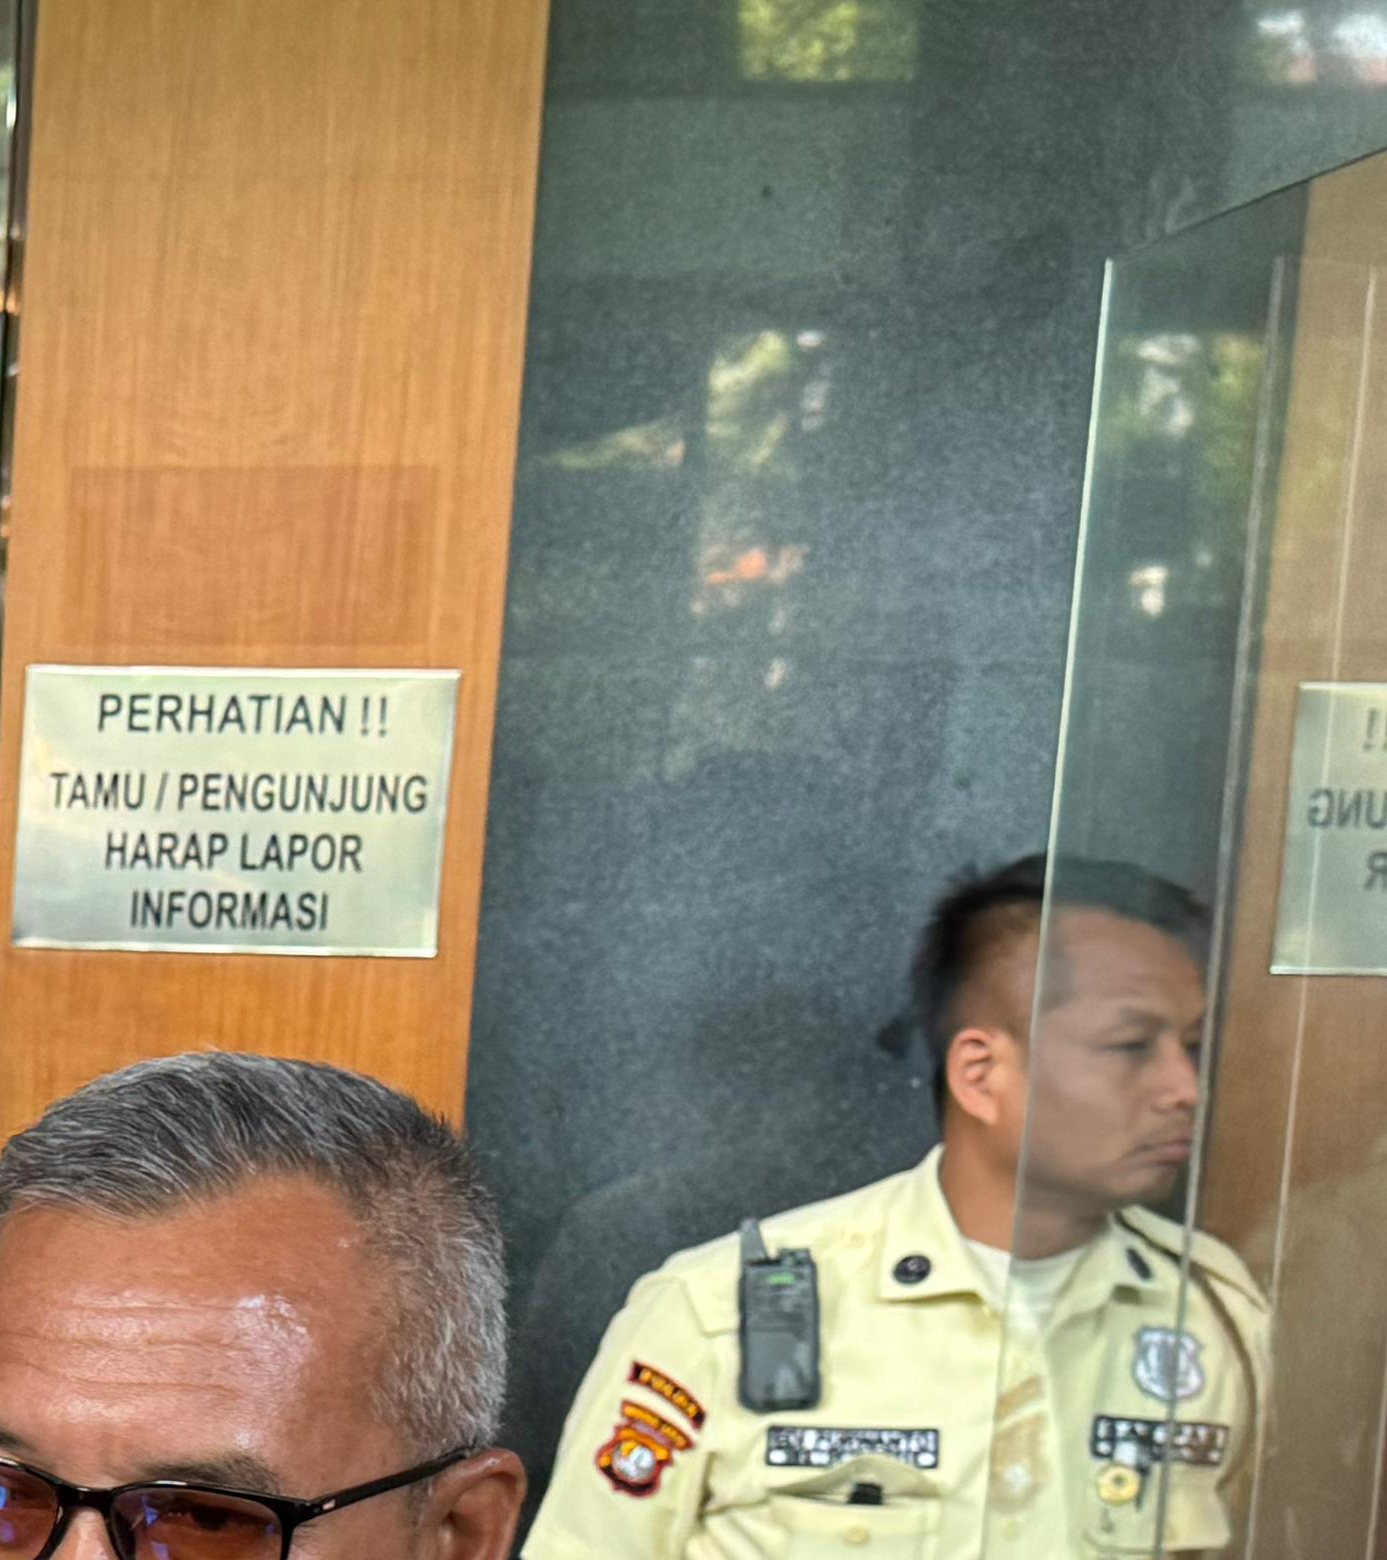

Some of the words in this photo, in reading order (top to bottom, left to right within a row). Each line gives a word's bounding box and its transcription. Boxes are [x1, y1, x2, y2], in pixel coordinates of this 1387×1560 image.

[97, 693, 346, 735] PERHATIAN
[50, 772, 146, 812] TAMU
[176, 773, 428, 814] PENGUNJUNG
[104, 831, 228, 872] HARAP
[240, 833, 363, 873] LAPOR
[129, 890, 330, 932] INFORMASI
